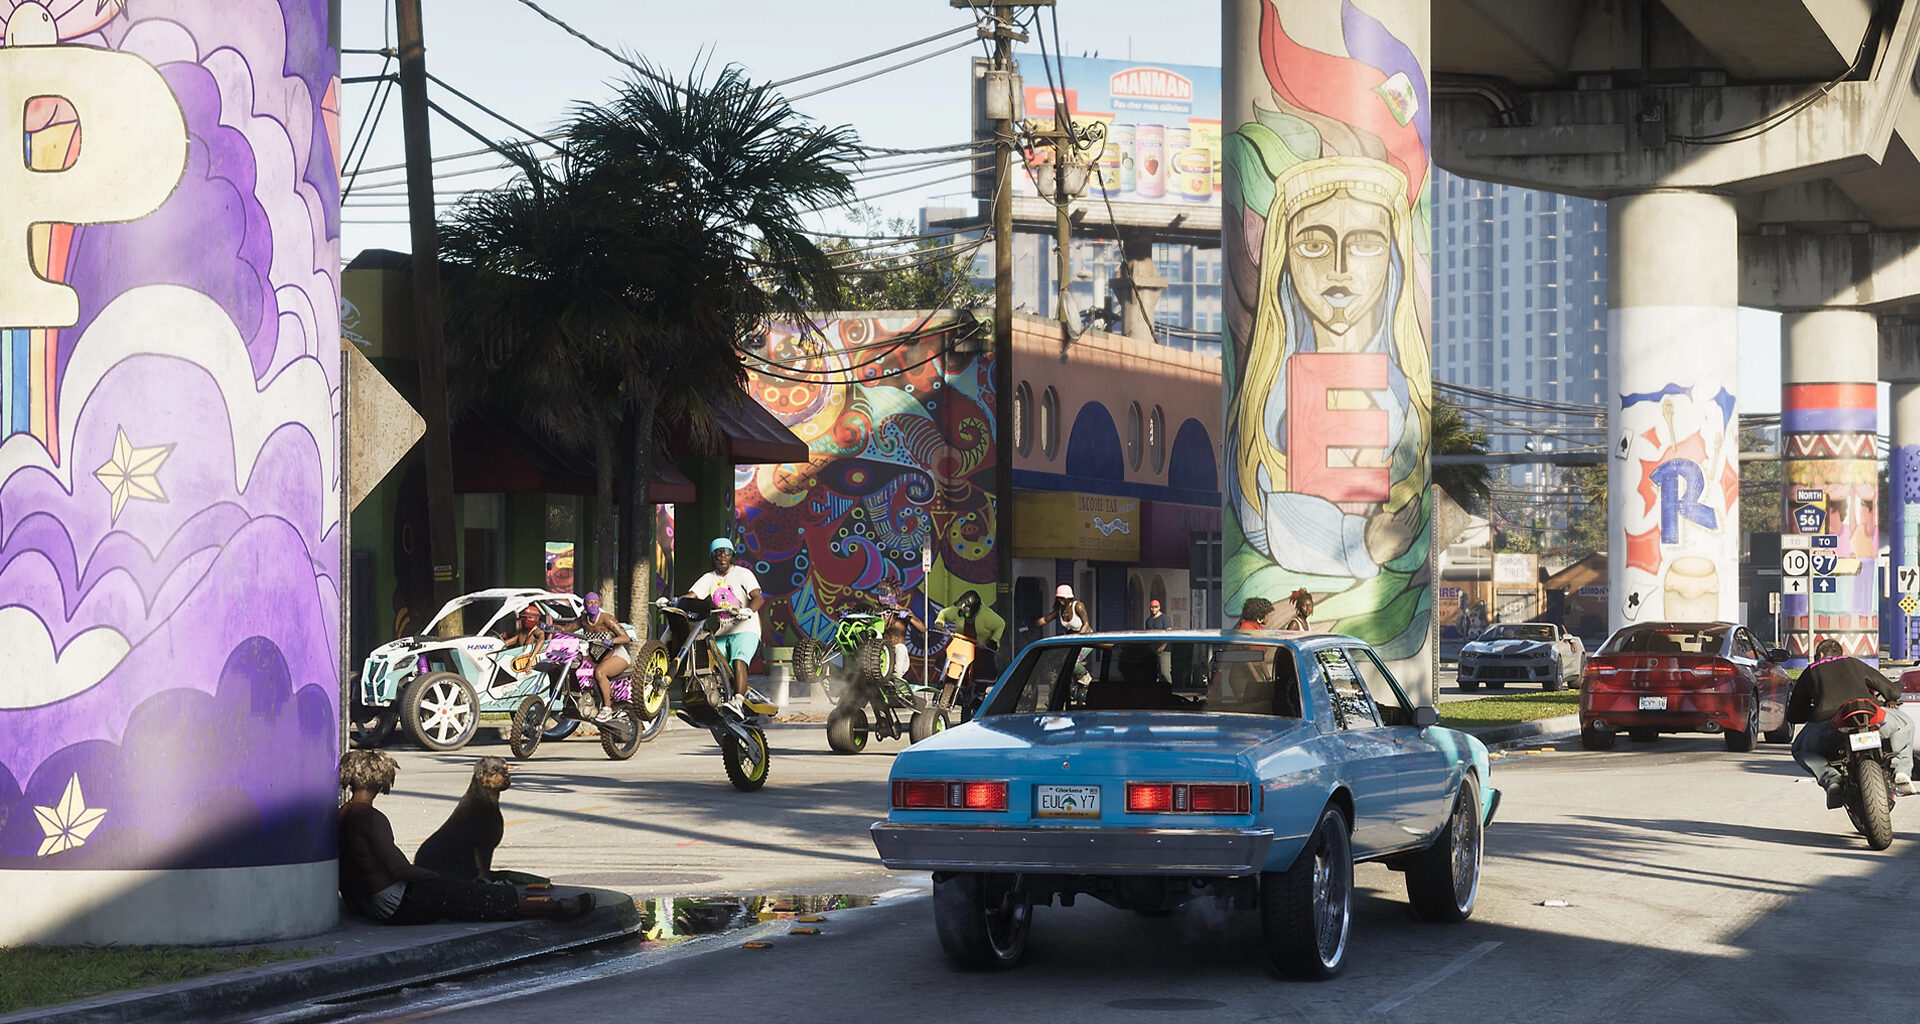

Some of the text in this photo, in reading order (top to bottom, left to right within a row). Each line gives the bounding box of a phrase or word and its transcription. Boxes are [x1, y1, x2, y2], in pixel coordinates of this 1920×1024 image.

[1112, 71, 1190, 98] MANMAN
[0, 45, 190, 329] P
[1287, 352, 1390, 503] E
[1649, 457, 1718, 544] R
[1798, 490, 1822, 500] NORTH
[1078, 496, 1103, 512] INCOME
[1105, 499, 1119, 513] TAX
[1799, 514, 1820, 526] 561
[1788, 555, 1804, 569] 10
[1813, 555, 1835, 571] 97
[1579, 587, 1609, 595] SIMON'
[467, 643, 494, 651] HAWX
[1080, 795, 1095, 809] Y7
